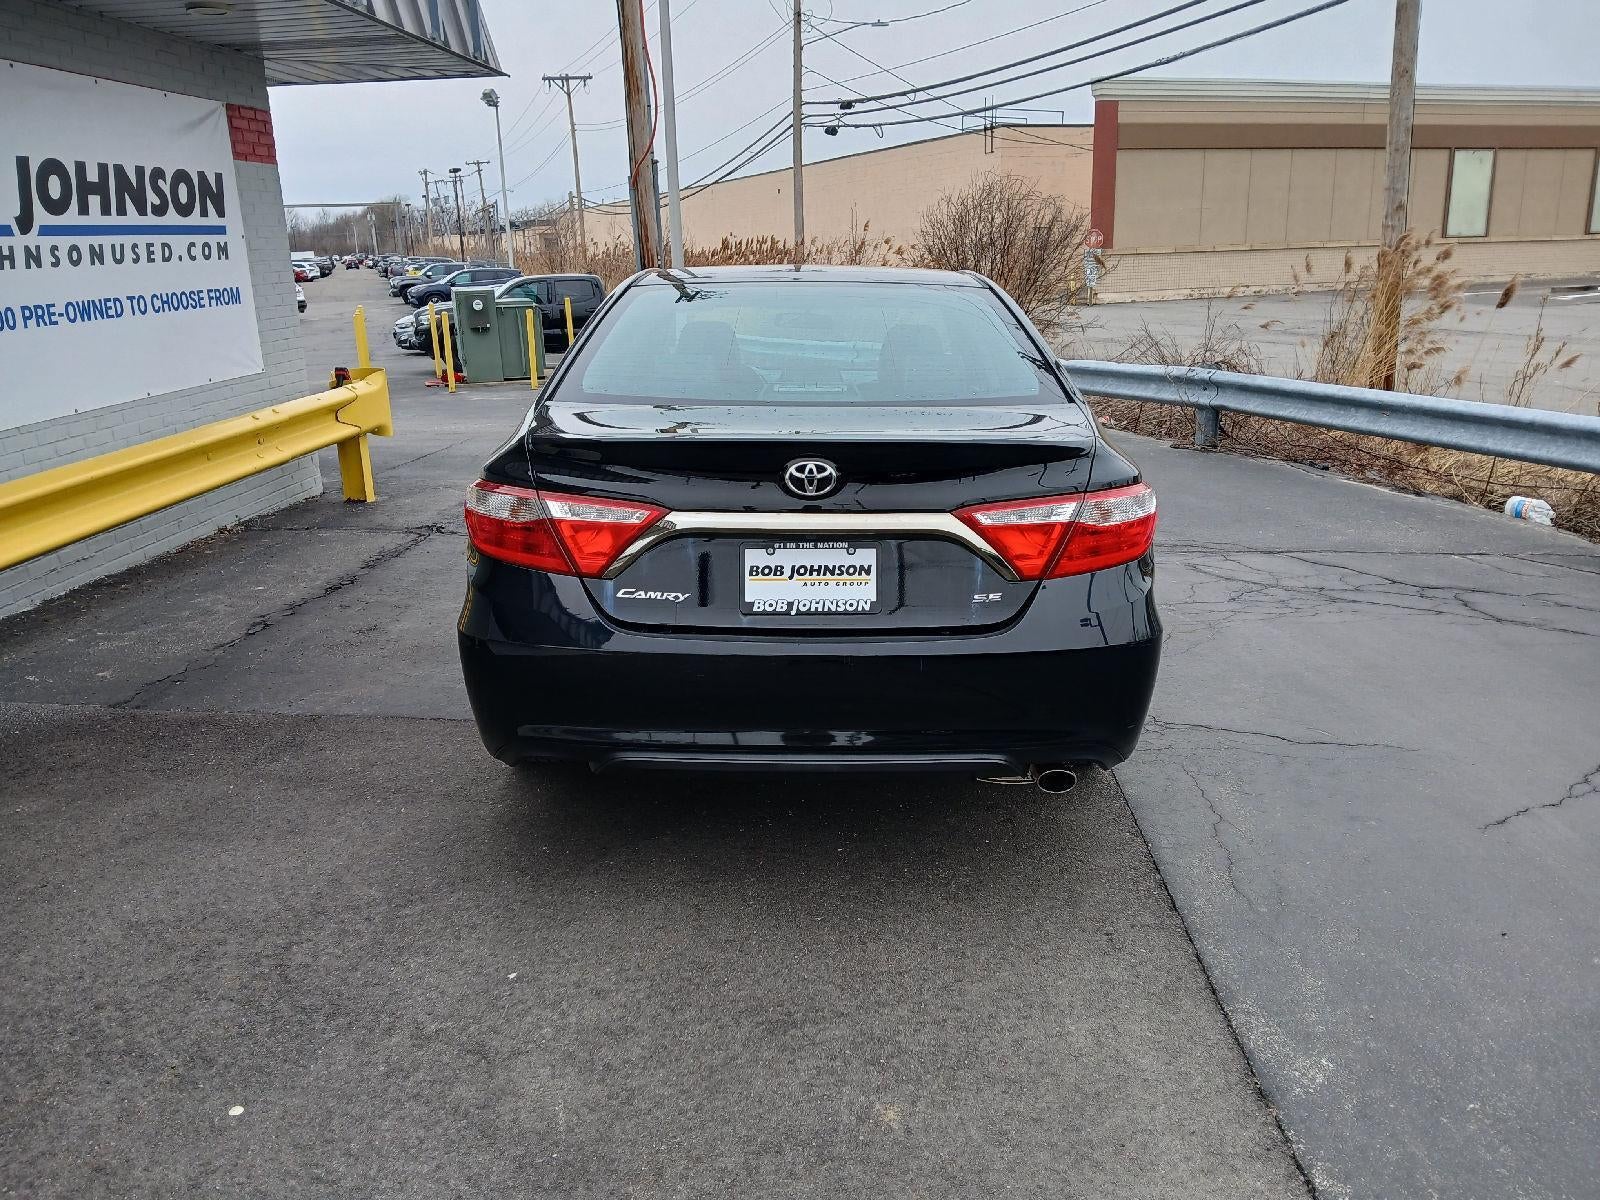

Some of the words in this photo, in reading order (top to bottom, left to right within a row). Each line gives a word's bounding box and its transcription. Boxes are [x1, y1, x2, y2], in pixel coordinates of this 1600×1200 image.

[13, 155, 226, 236] JOHNSON
[20, 297, 124, 329] PRE-OWNED
[126, 295, 148, 316] TO
[150, 289, 206, 314] CHOOSE
[207, 286, 242, 308] FROM
[817, 541, 849, 549] NATION
[749, 564, 785, 577] BOB
[788, 564, 873, 581] JOHNSON
[616, 588, 692, 603] CAMRY
[972, 592, 1003, 603] SE
[752, 599, 789, 612] BOB
[790, 599, 872, 616] JOHNSON
